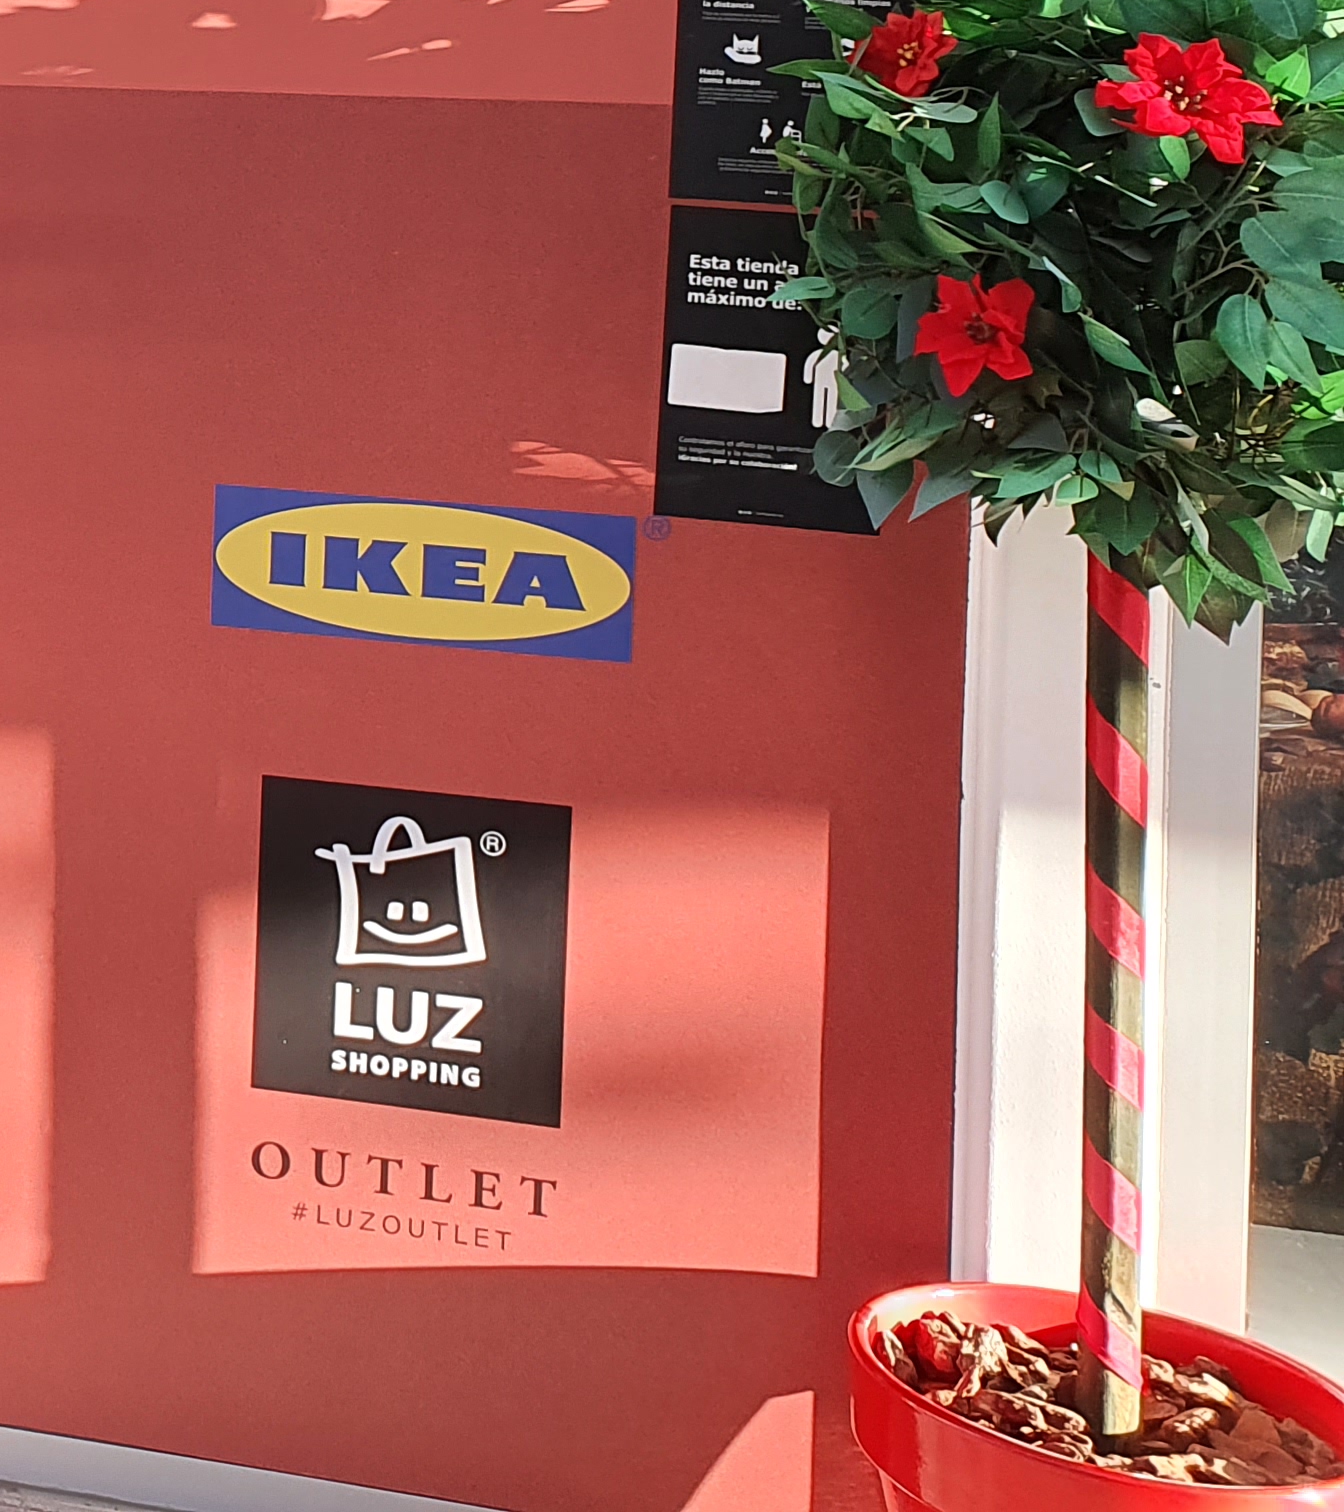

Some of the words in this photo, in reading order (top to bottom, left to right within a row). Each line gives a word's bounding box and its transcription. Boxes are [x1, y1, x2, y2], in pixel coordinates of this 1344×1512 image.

[688, 272, 738, 288] tiene
[743, 278, 769, 291] un
[689, 254, 731, 271] Esta
[736, 257, 799, 275] tienda
[687, 289, 767, 308] máximo
[268, 531, 587, 611] IKEA
[331, 981, 483, 1055] LUZ
[330, 1049, 482, 1088] SHOPPING
[251, 1141, 558, 1218] OUTLET
[291, 1202, 513, 1251] #LUZOUTLET
